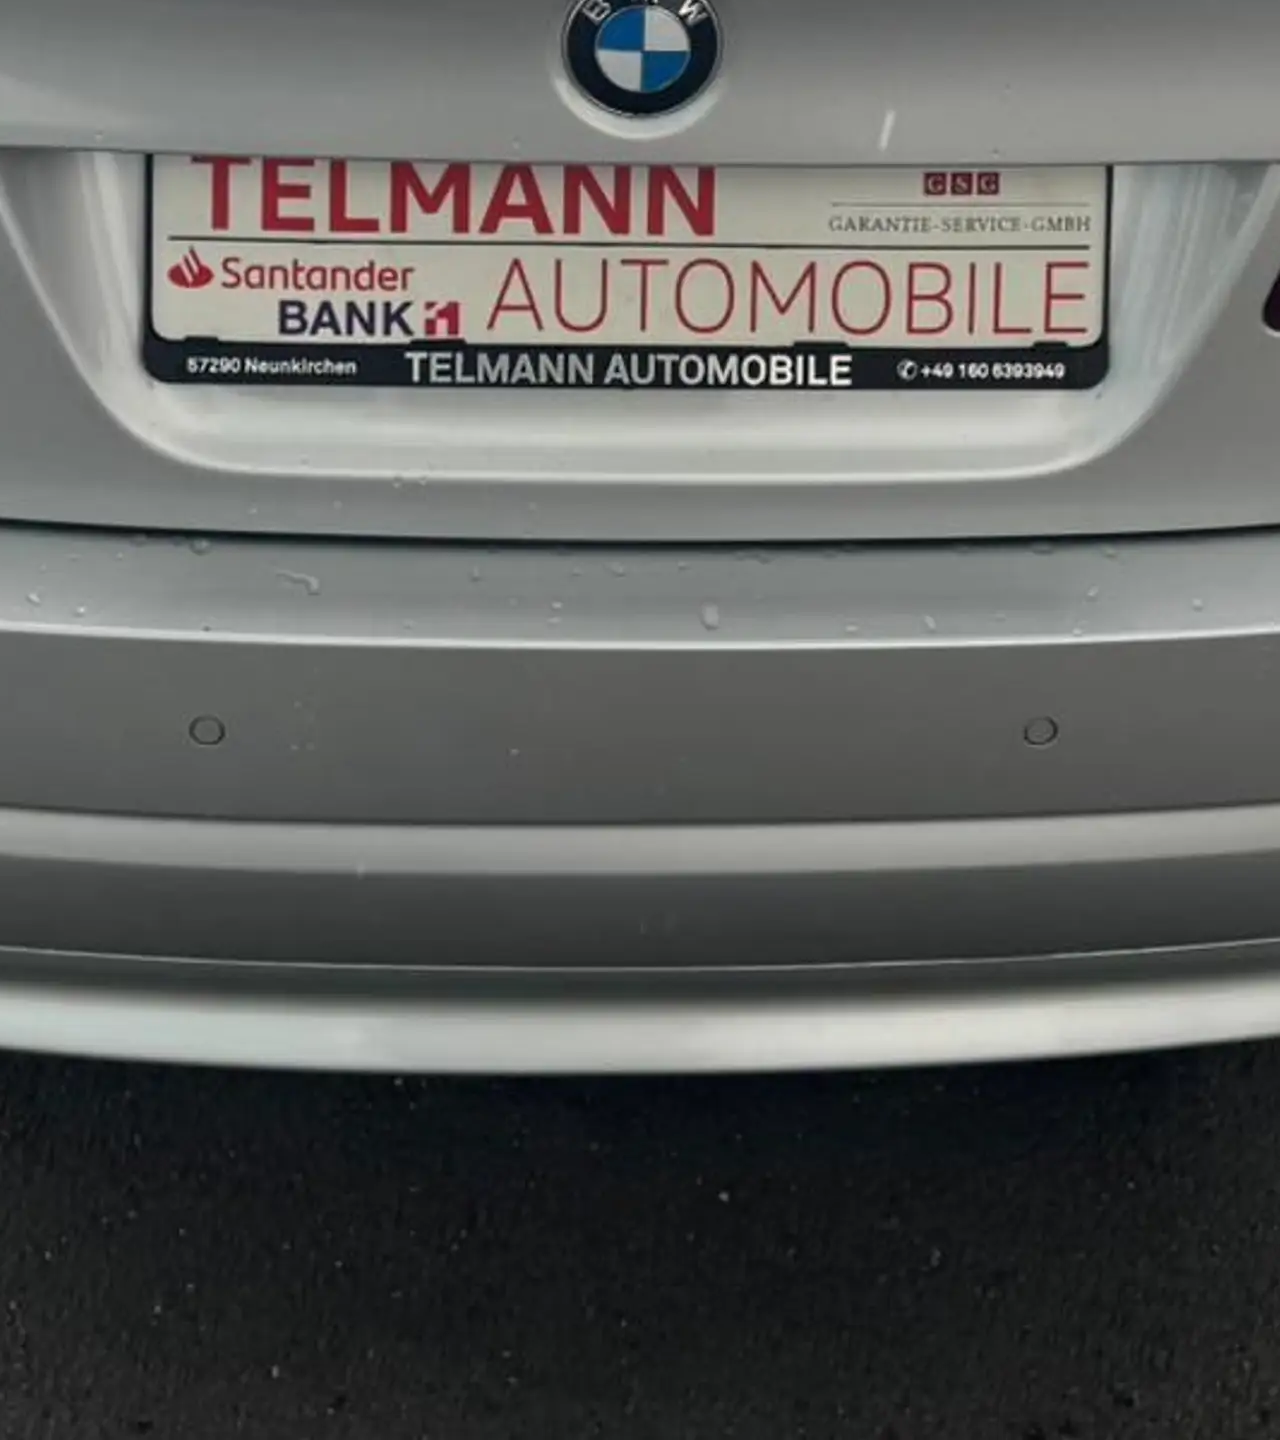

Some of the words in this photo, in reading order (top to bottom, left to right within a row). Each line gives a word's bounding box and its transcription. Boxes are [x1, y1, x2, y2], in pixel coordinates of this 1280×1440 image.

[191, 156, 716, 236] TELMANN
[221, 257, 415, 292] Santander
[486, 257, 1090, 336] AUTOMOBILE
[278, 300, 414, 336] BANK
[243, 357, 358, 375] Neunkirchen
[404, 352, 594, 385] TELMANN
[604, 353, 853, 386] AUTOMOBILE
